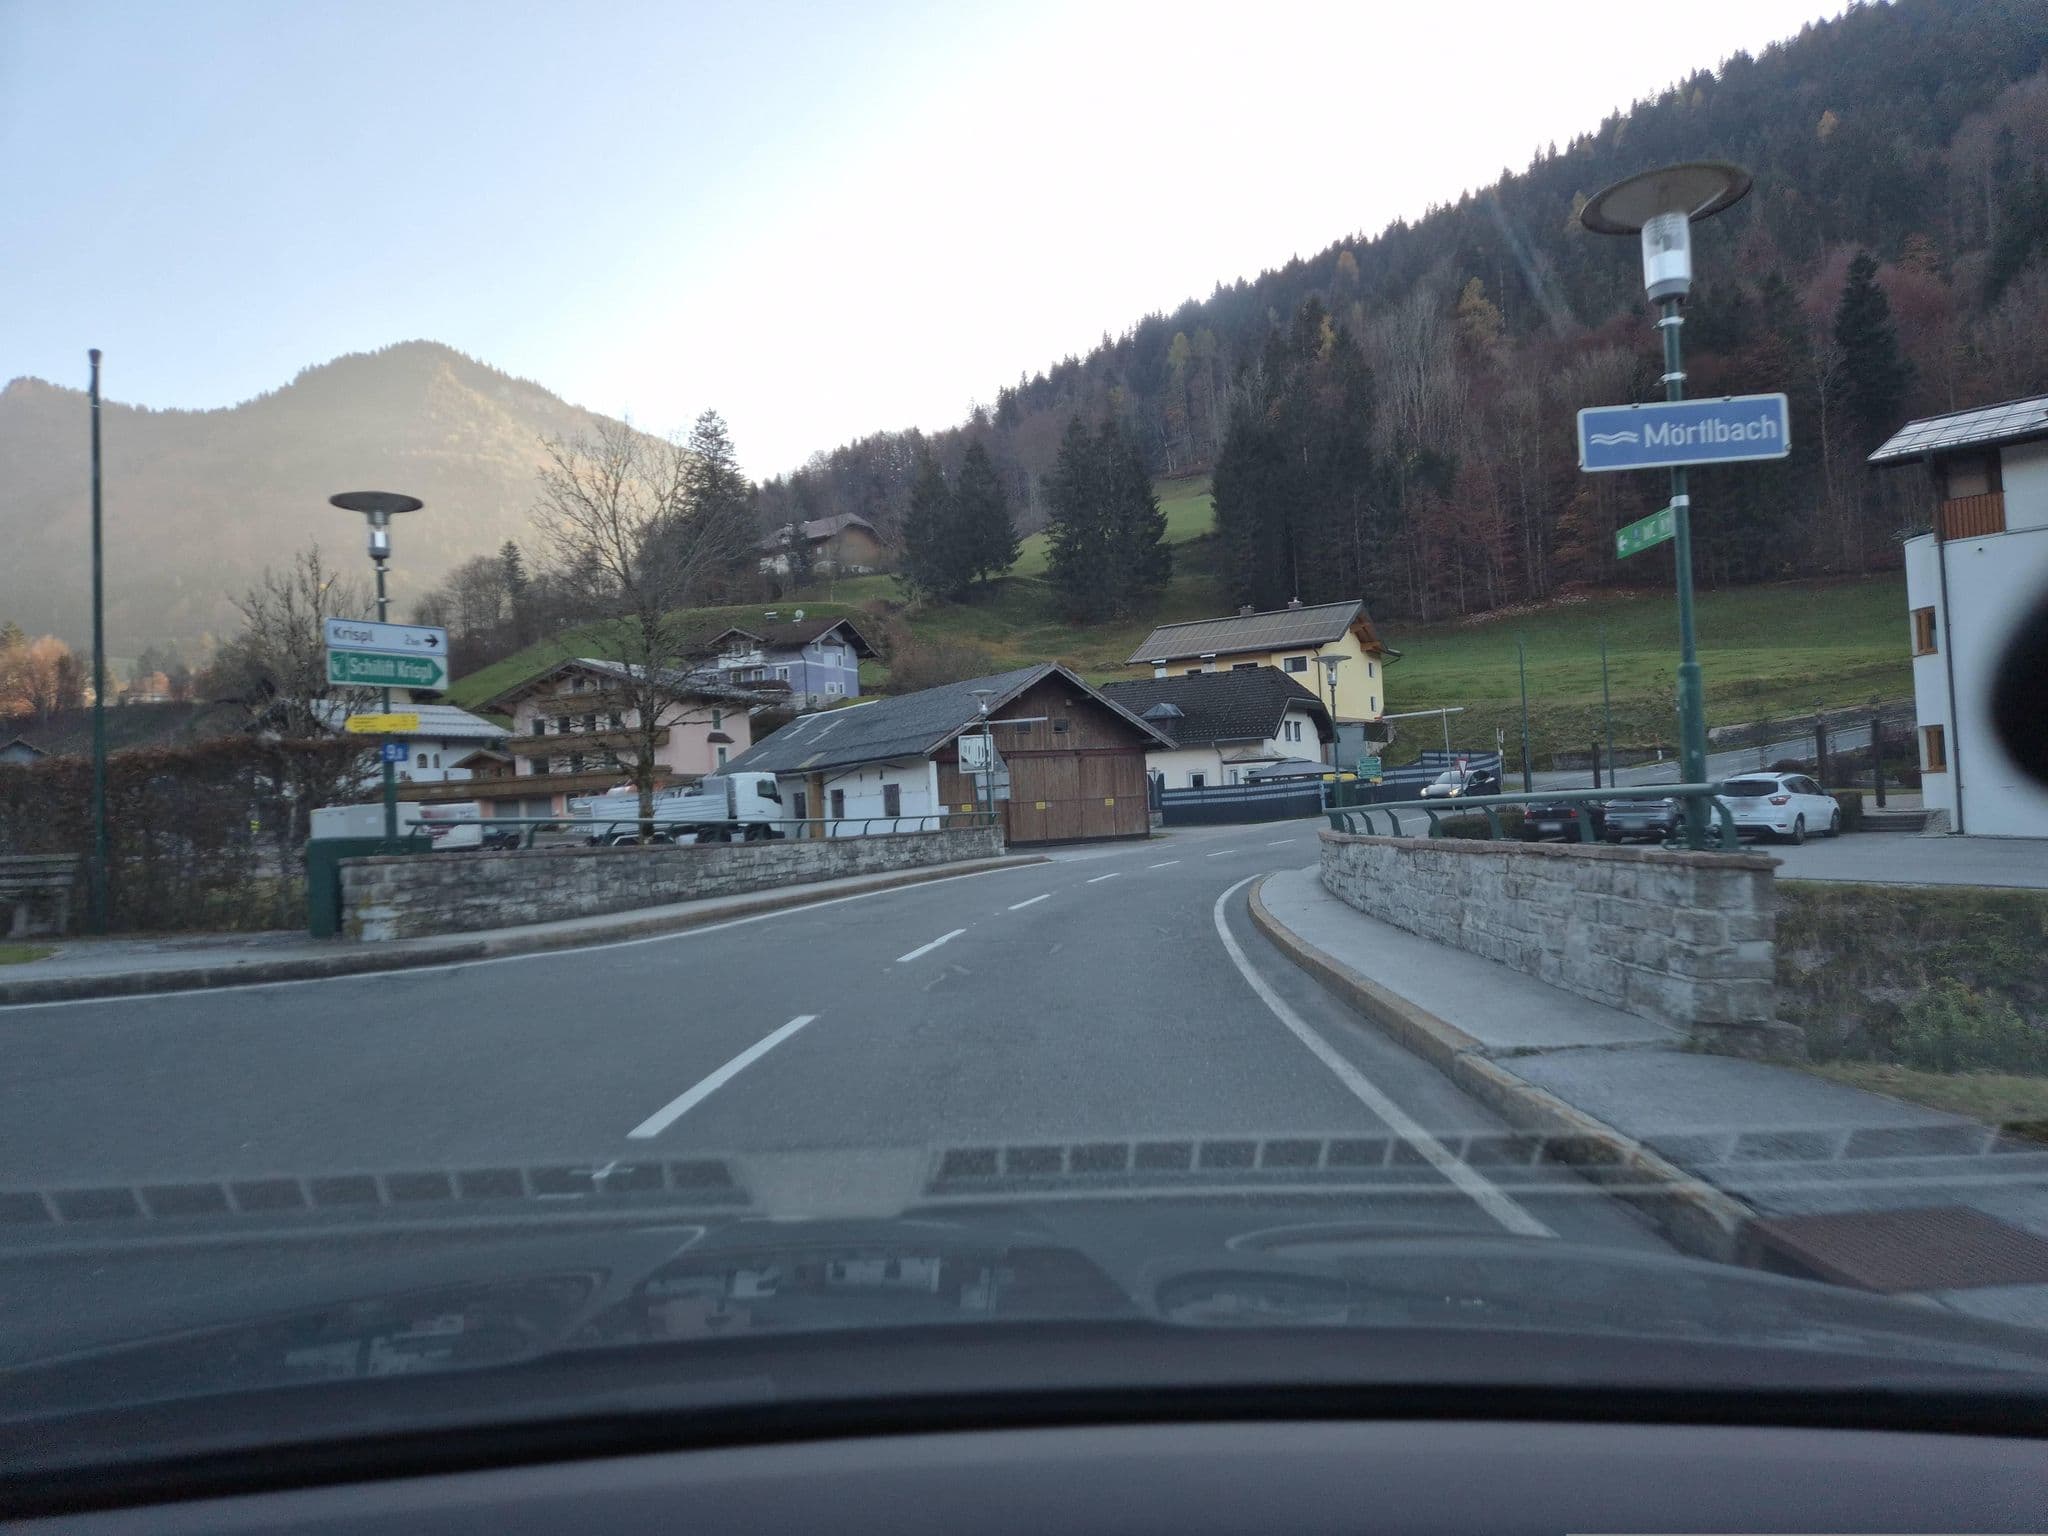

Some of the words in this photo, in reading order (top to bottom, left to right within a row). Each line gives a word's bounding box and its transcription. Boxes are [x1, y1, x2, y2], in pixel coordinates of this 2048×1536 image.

[1644, 414, 1778, 448] Mörtlbach
[333, 626, 375, 645] Krispl
[397, 660, 433, 683] Krispl
